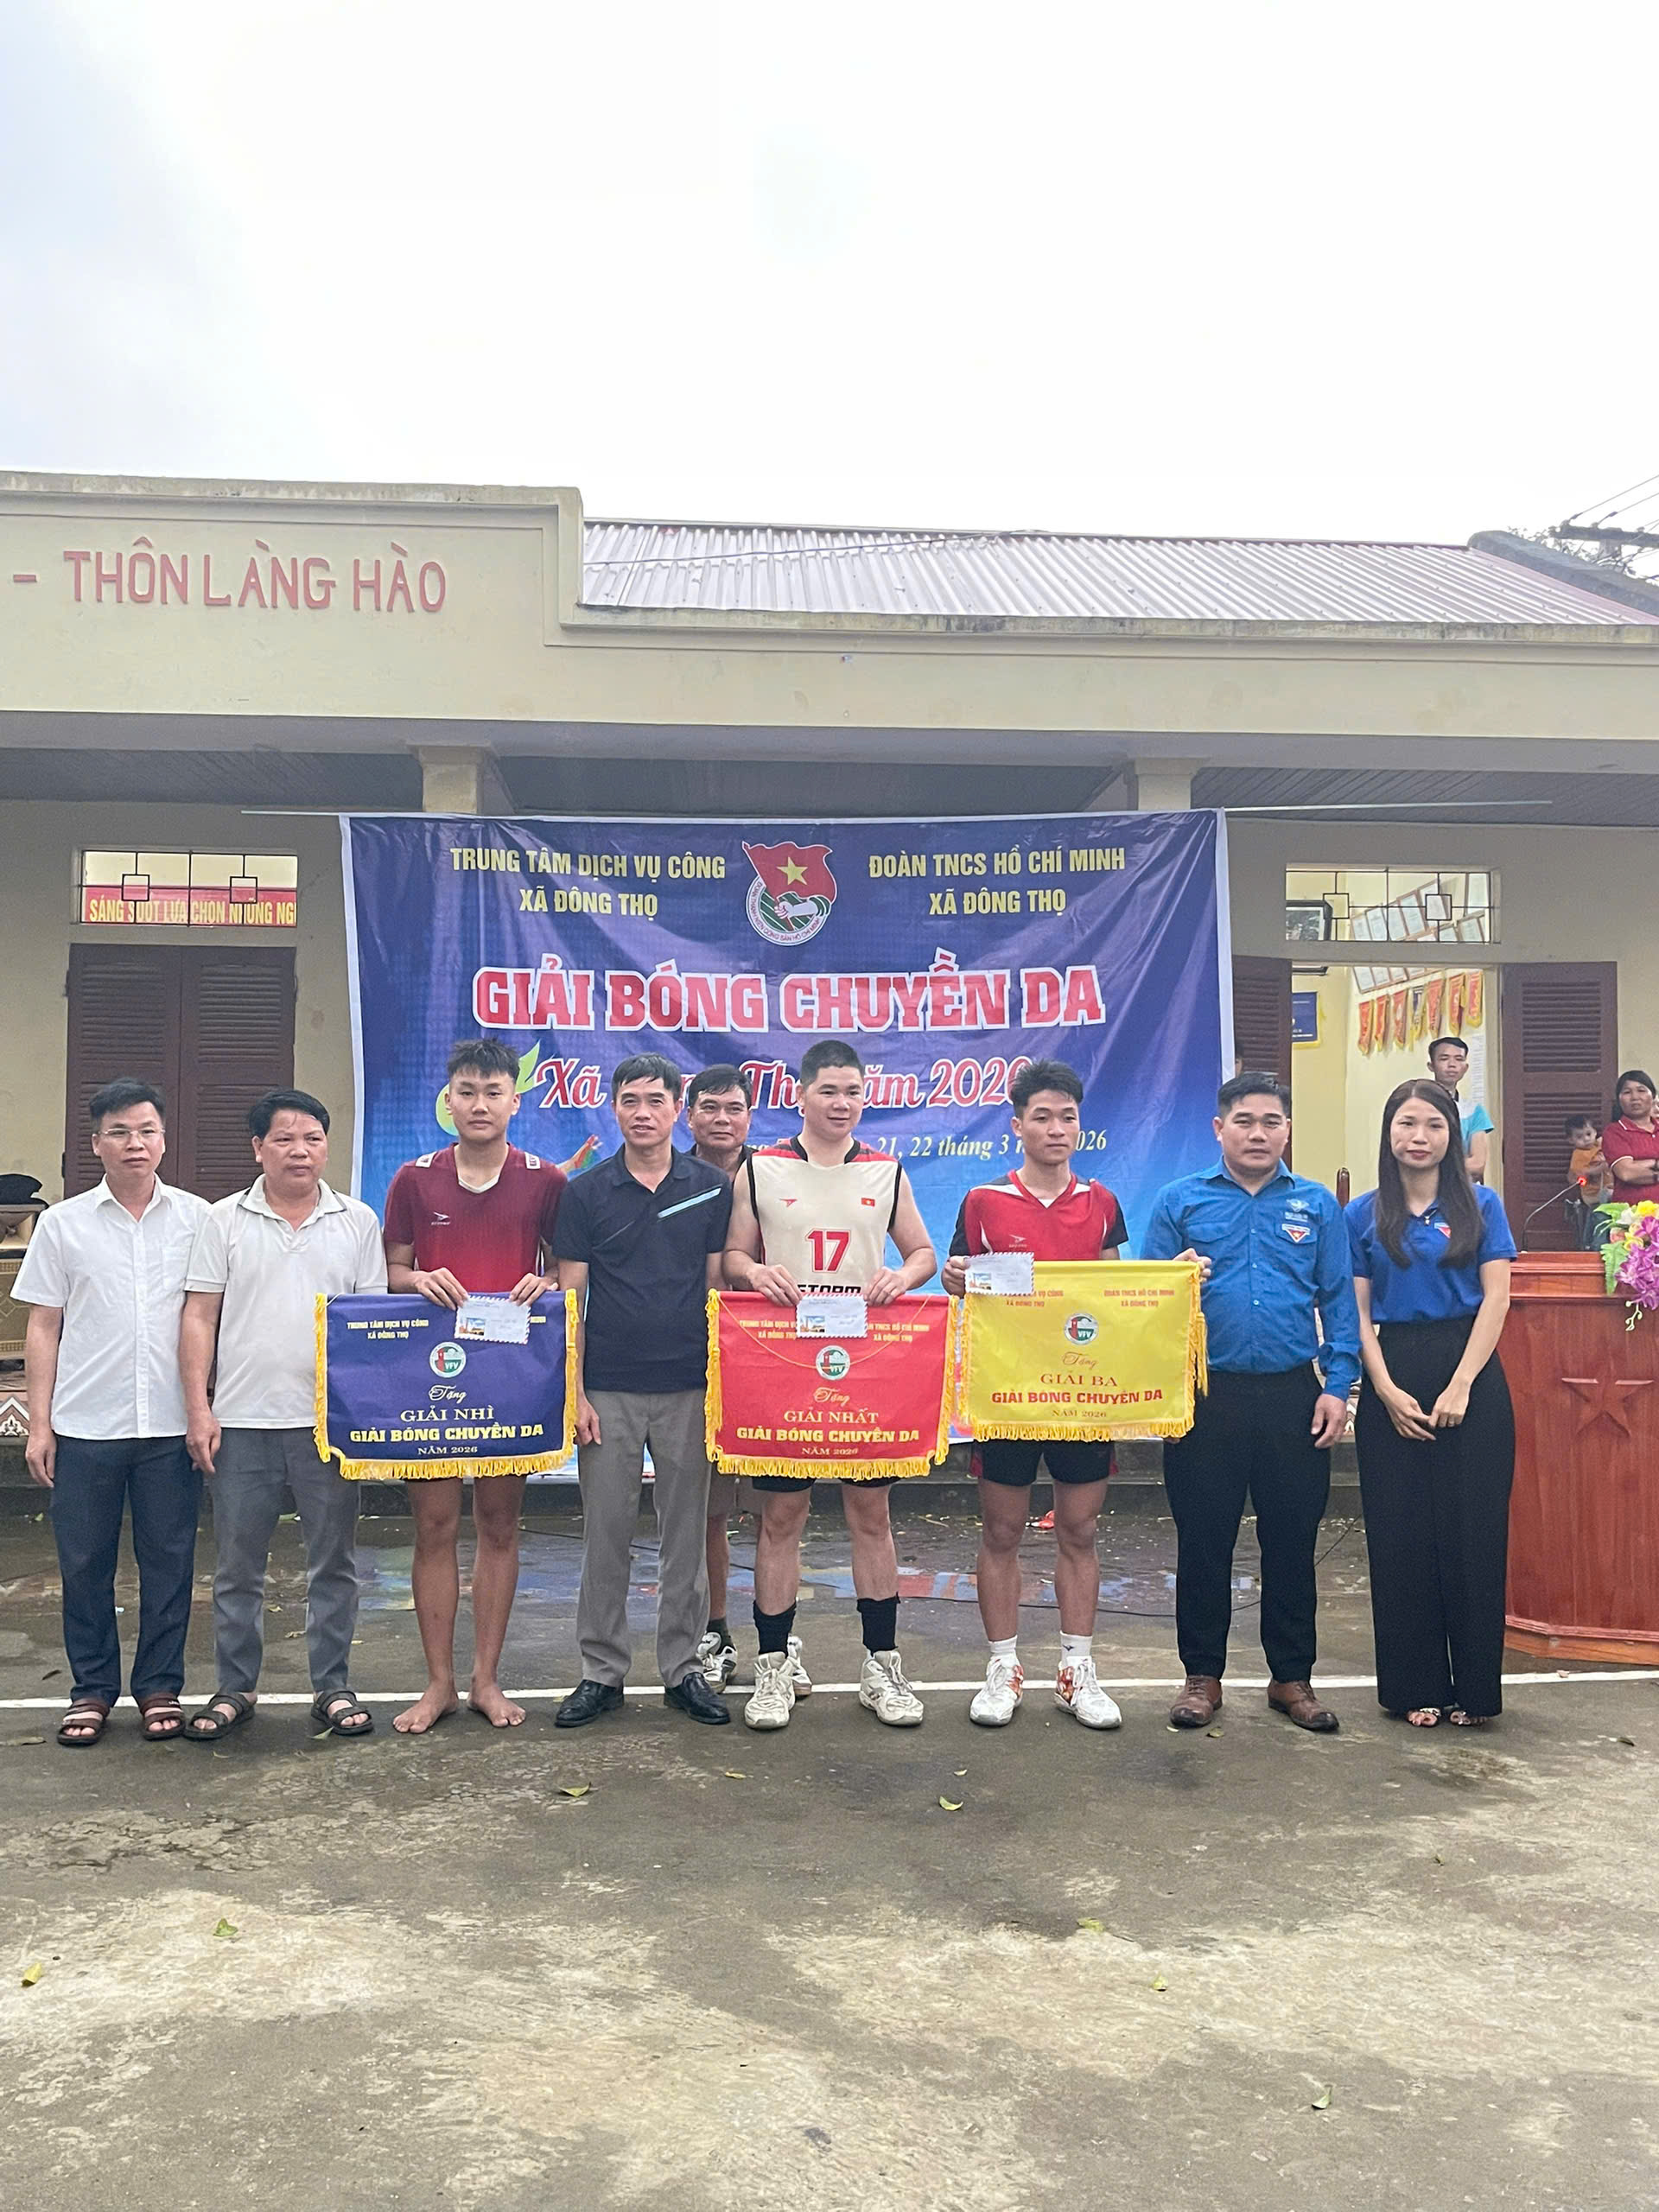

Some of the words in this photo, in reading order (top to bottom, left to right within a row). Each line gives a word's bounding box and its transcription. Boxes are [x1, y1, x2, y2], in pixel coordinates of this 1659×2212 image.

[63, 537, 189, 605] THÔN
[203, 539, 336, 609] LÀNG
[353, 541, 446, 613] HÀO
[450, 848, 520, 872] TRUNG
[525, 847, 571, 874] TÂM
[578, 854, 627, 881] DỊCH
[633, 855, 661, 882] VỤ
[668, 851, 726, 879] CÔNG
[868, 850, 926, 878] ĐOÀN
[932, 853, 987, 877] TNCS
[994, 843, 1022, 875] HỒ
[1028, 845, 1062, 874] CHÍ
[1069, 848, 1126, 872] MINH
[89, 894, 124, 922] SÁNG
[519, 886, 549, 912] XÃ
[554, 887, 612, 914] ĐÔNG
[618, 893, 658, 921] THỌ
[929, 888, 957, 915] XÃ
[963, 887, 1021, 914] ĐÔNG
[1027, 888, 1066, 916] THỌ
[472, 953, 594, 1029] GIẢI
[605, 958, 768, 1032] BÓNG
[779, 948, 1010, 1033] CHUYỀN
[1020, 965, 1106, 1026] DA
[534, 1058, 607, 1108] Xã
[739, 1059, 805, 1116] Th
[863, 1064, 926, 1109] ăm
[912, 1136, 931, 1156] 22
[938, 1135, 993, 1160] tháng
[999, 1134, 1009, 1154] 3
[1075, 1128, 1107, 1151] 026
[804, 1228, 851, 1274] 17
[1092, 1376, 1118, 1387] BA
[1144, 1389, 1163, 1402] DA
[400, 1405, 448, 1422] GIẢI
[454, 1405, 495, 1421] NHÌ
[784, 1407, 823, 1423] GIẢI
[350, 1427, 386, 1443] GIẢI
[391, 1427, 441, 1442] BÓNG
[445, 1421, 517, 1440] CHUYỀN
[521, 1424, 544, 1438] DA
[736, 1426, 772, 1441] GIẢI
[776, 1427, 823, 1442] BÓNG
[899, 1429, 919, 1442] DA
